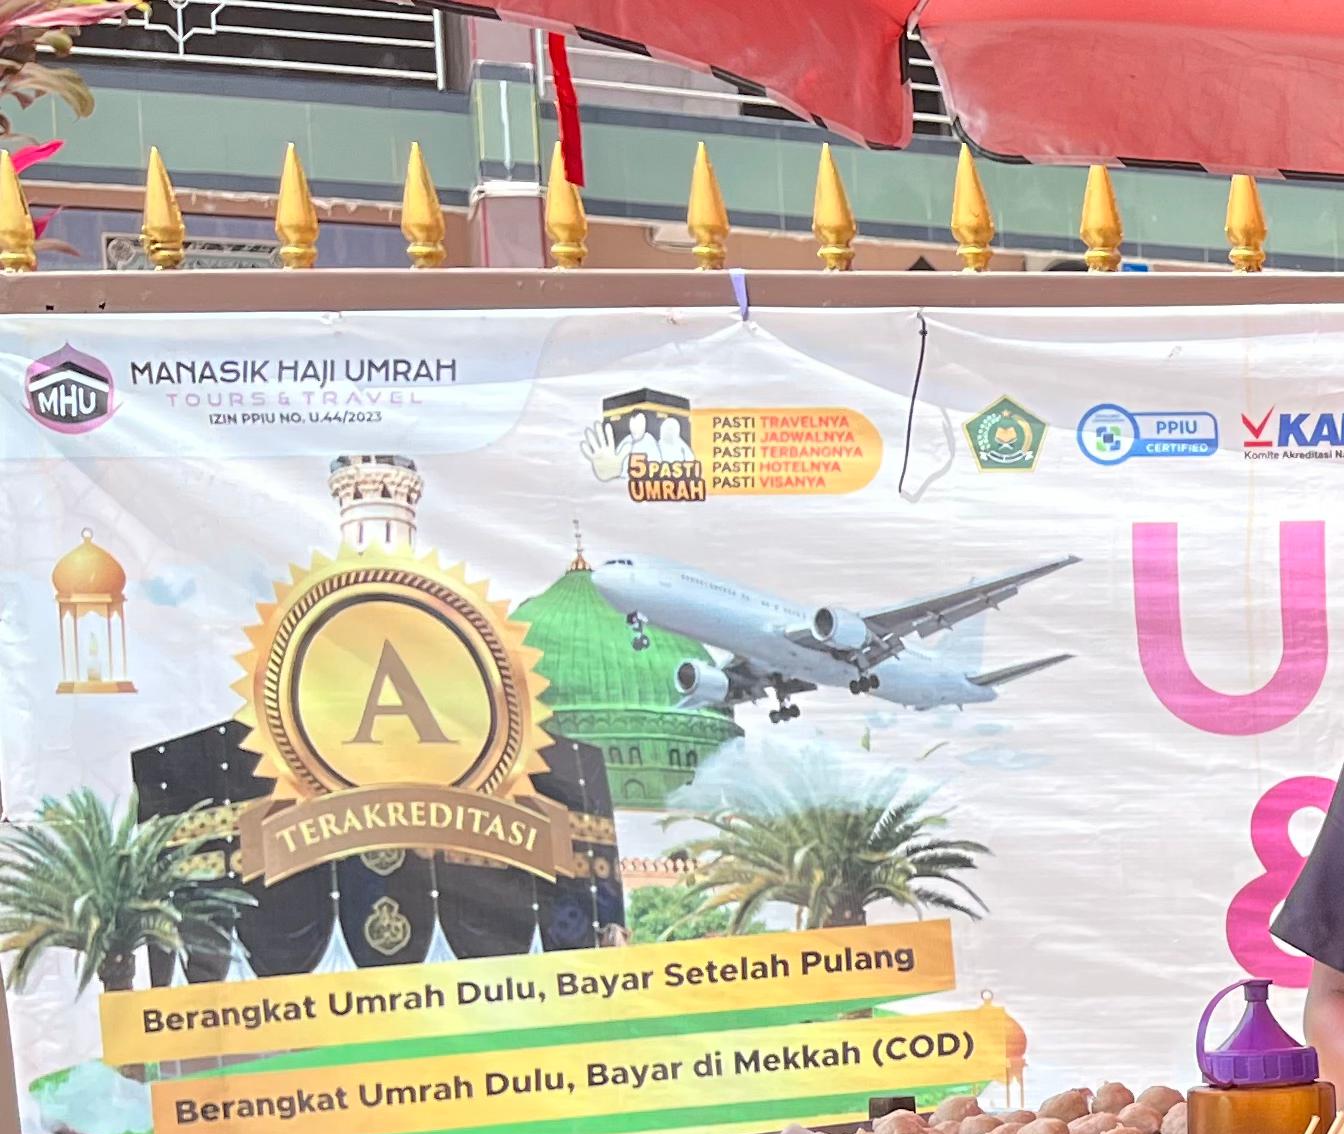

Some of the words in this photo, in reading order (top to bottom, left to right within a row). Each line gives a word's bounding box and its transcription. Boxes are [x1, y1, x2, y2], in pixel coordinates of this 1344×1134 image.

[130, 360, 271, 385] MANASIK
[278, 360, 335, 388] HAJI
[346, 359, 457, 383] UMRAH
[38, 382, 97, 417] MHU
[166, 392, 265, 407] TOURS
[278, 392, 291, 406] &
[302, 391, 424, 406] TRAVEL
[209, 413, 237, 425] IZIN
[242, 413, 276, 425] PPIU
[280, 412, 305, 425] NO.
[309, 411, 383, 425] U.44/2023
[712, 417, 756, 429] PASTI
[760, 417, 849, 428] TRAVELNYA
[1156, 420, 1198, 434] PPIU
[712, 432, 756, 444] PASTI
[760, 432, 854, 443] JADWALNYA
[712, 447, 756, 459] PASTI
[760, 447, 863, 458] TERBANGNYA
[1146, 443, 1208, 453] CERTIFIED
[1244, 451, 1279, 460] Komite
[1282, 450, 1333, 460] Akreditasi
[629, 454, 647, 478] 5
[648, 460, 701, 479] PASTI
[712, 462, 756, 474] PASTI
[760, 462, 841, 473] HOTELNYA
[630, 480, 705, 501] UMRAH
[712, 477, 756, 489] PASTI
[760, 477, 826, 488] VISANYA
[342, 639, 461, 744] A
[275, 801, 538, 853] TERAKREDITASI
[143, 996, 316, 1034] Berangkat
[330, 983, 445, 1015] Umrah
[457, 976, 547, 1005] Dulu,
[557, 967, 654, 998] Bayar
[664, 953, 790, 987] Setelah
[800, 945, 915, 976] Pulang
[176, 1086, 348, 1124] Berangkat
[359, 1075, 473, 1107] Umrah
[485, 1068, 576, 1097] Dulu,
[587, 1059, 682, 1092] Bayar
[693, 1048, 723, 1076] di
[734, 1040, 861, 1074] Mekkah
[871, 1030, 975, 1068] (COD)
